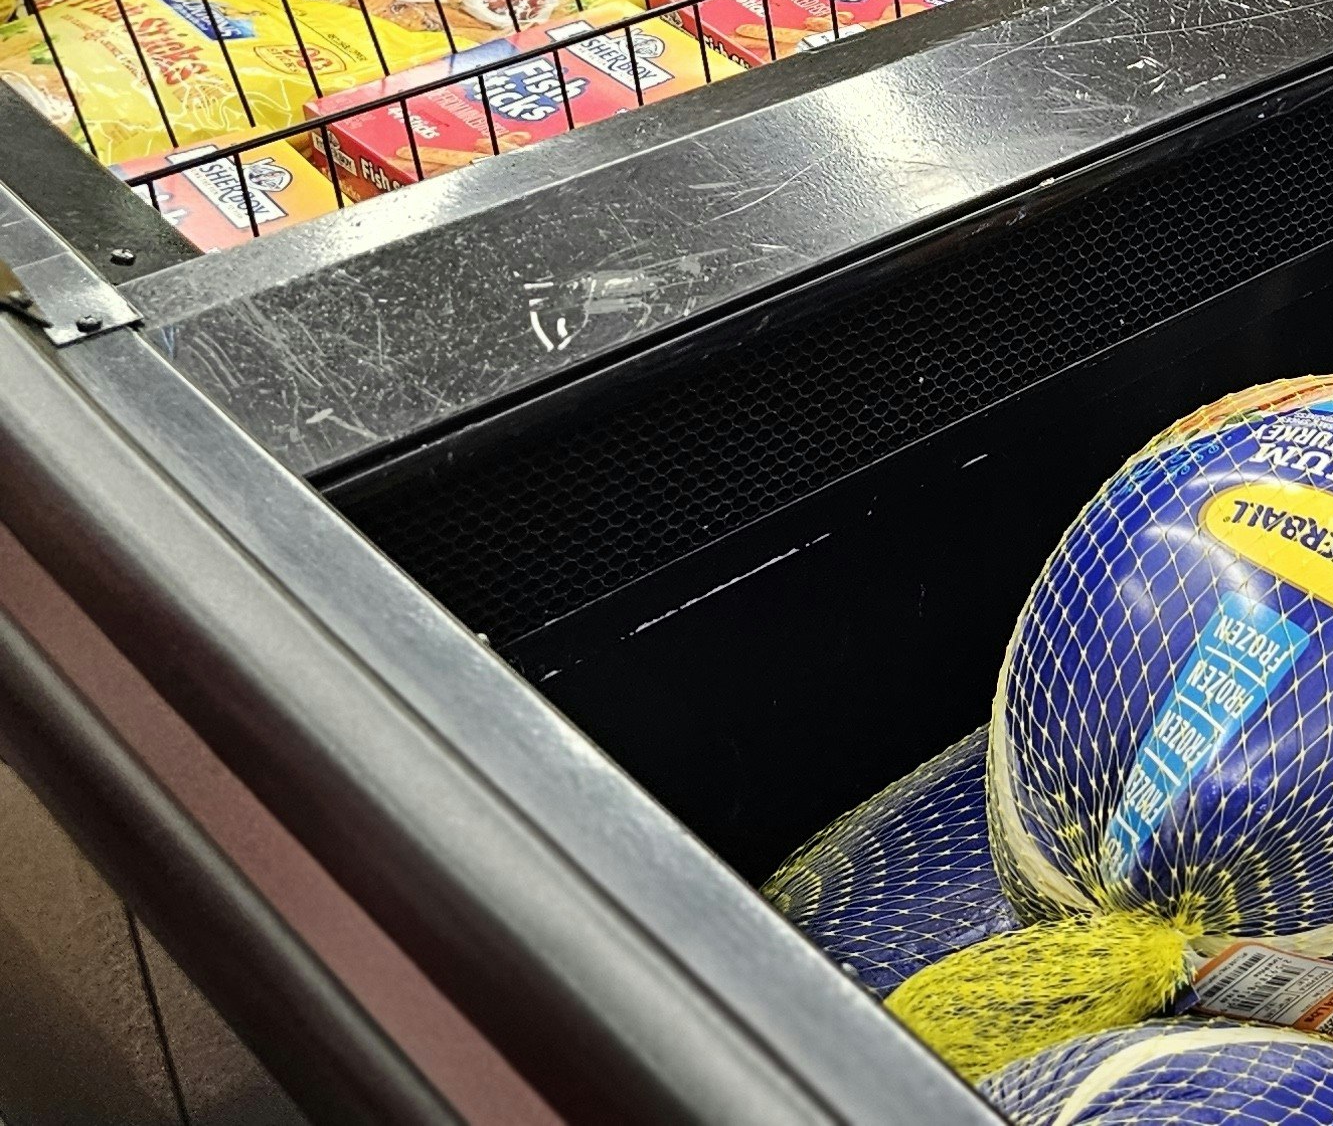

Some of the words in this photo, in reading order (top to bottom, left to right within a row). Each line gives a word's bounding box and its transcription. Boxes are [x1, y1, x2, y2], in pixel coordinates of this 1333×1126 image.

[360, 158, 391, 191] Fish
[1212, 614, 1291, 674] FROZEN
[1185, 660, 1256, 720] FROZEN
[1157, 709, 1213, 766] FROZEN
